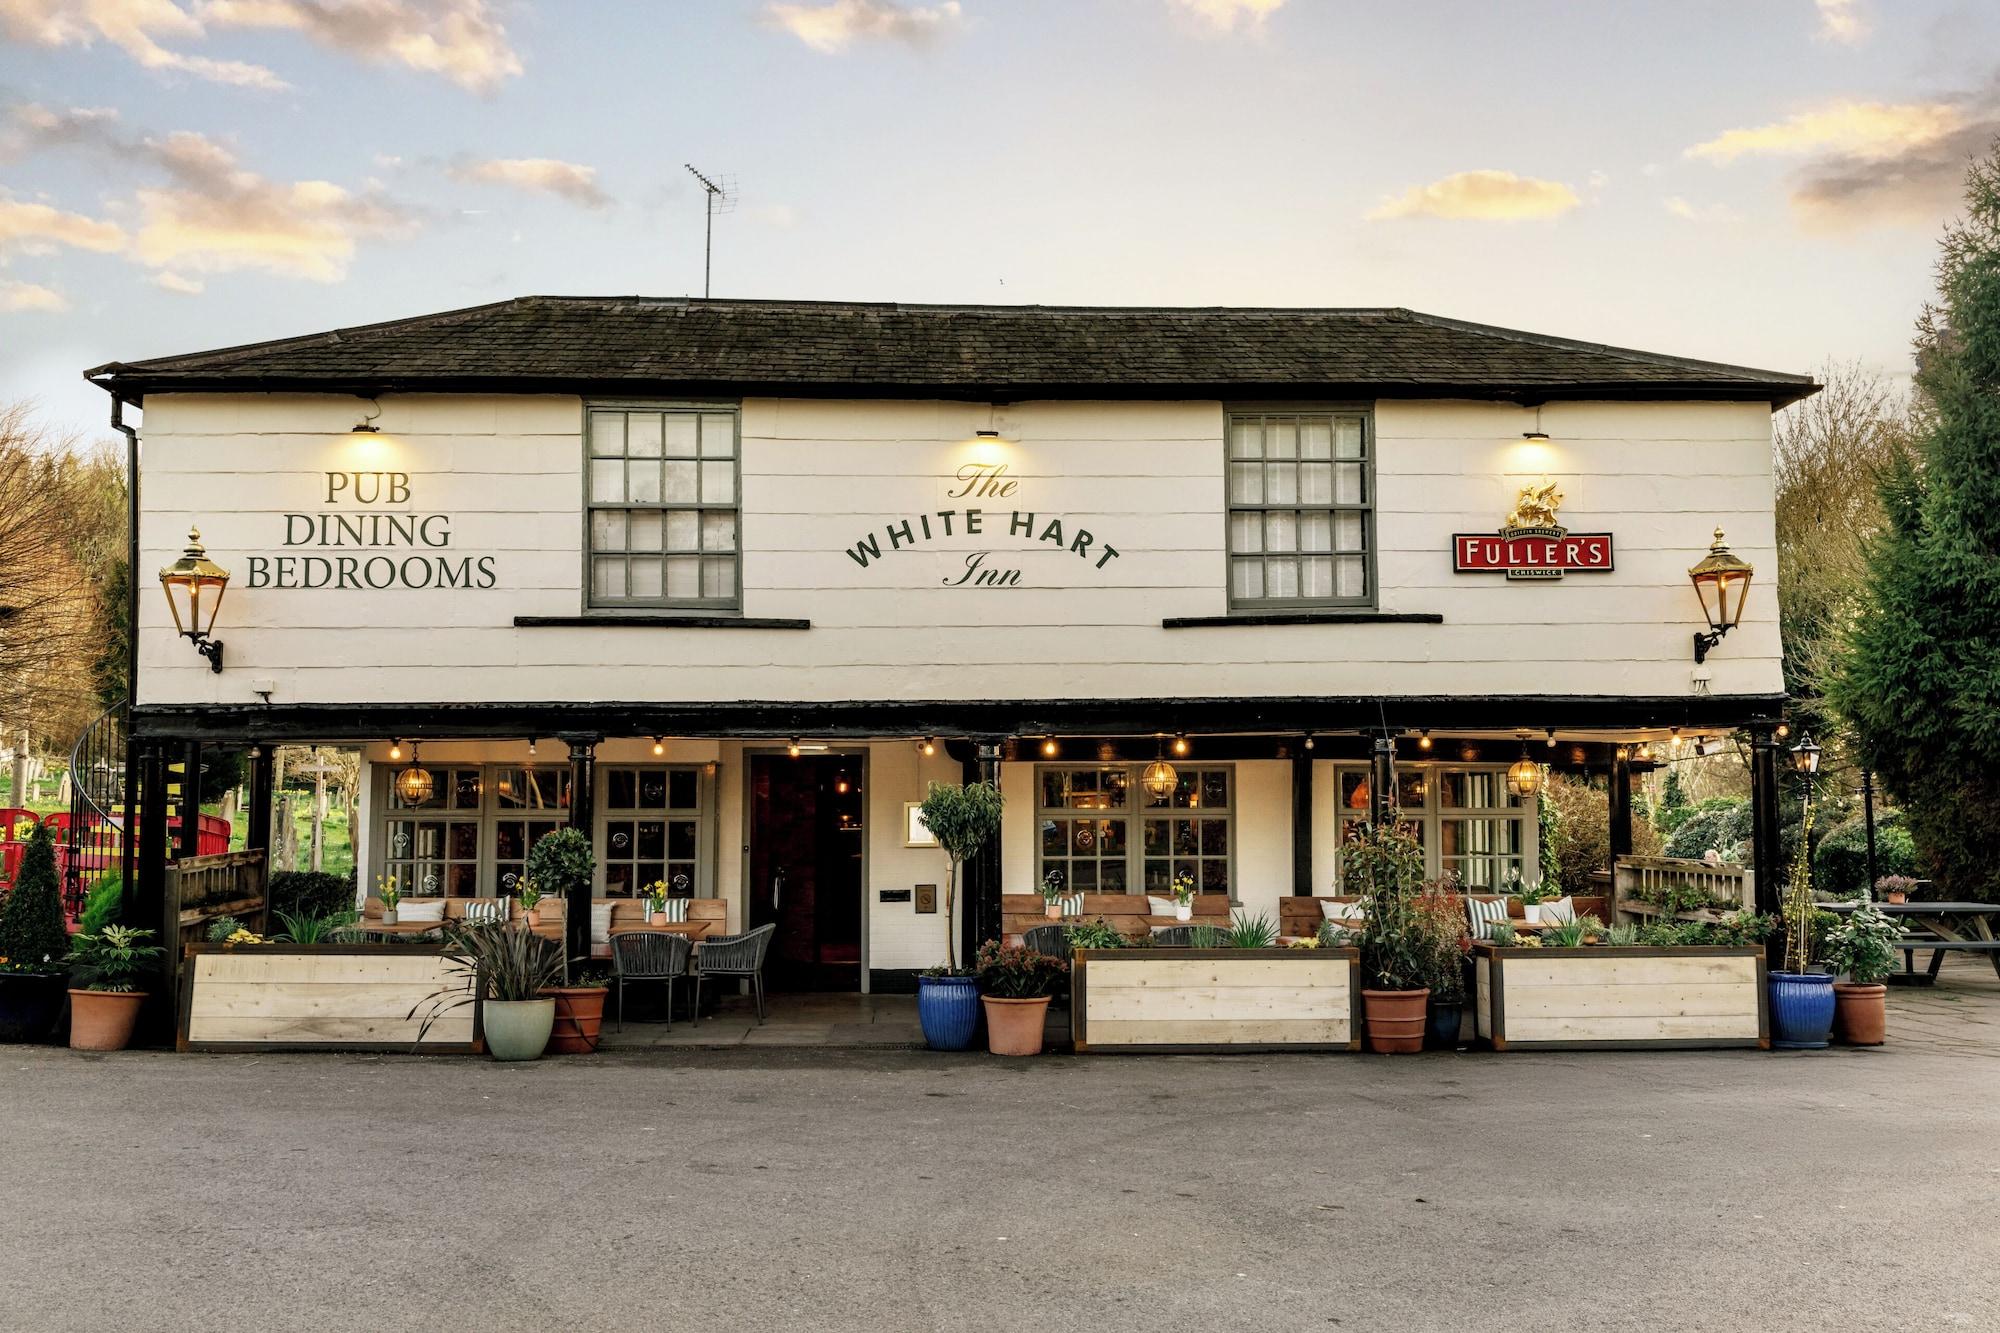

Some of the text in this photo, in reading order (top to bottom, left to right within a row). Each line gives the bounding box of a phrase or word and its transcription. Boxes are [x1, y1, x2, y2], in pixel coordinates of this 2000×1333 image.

[324, 472, 411, 504] PUB
[947, 463, 1019, 499] The
[282, 514, 451, 547] DINING
[846, 508, 1120, 570] WHITE HART
[1466, 538, 1602, 566] FULLER'S
[245, 556, 496, 589] BEDROOMS
[942, 552, 1021, 587] Inn
